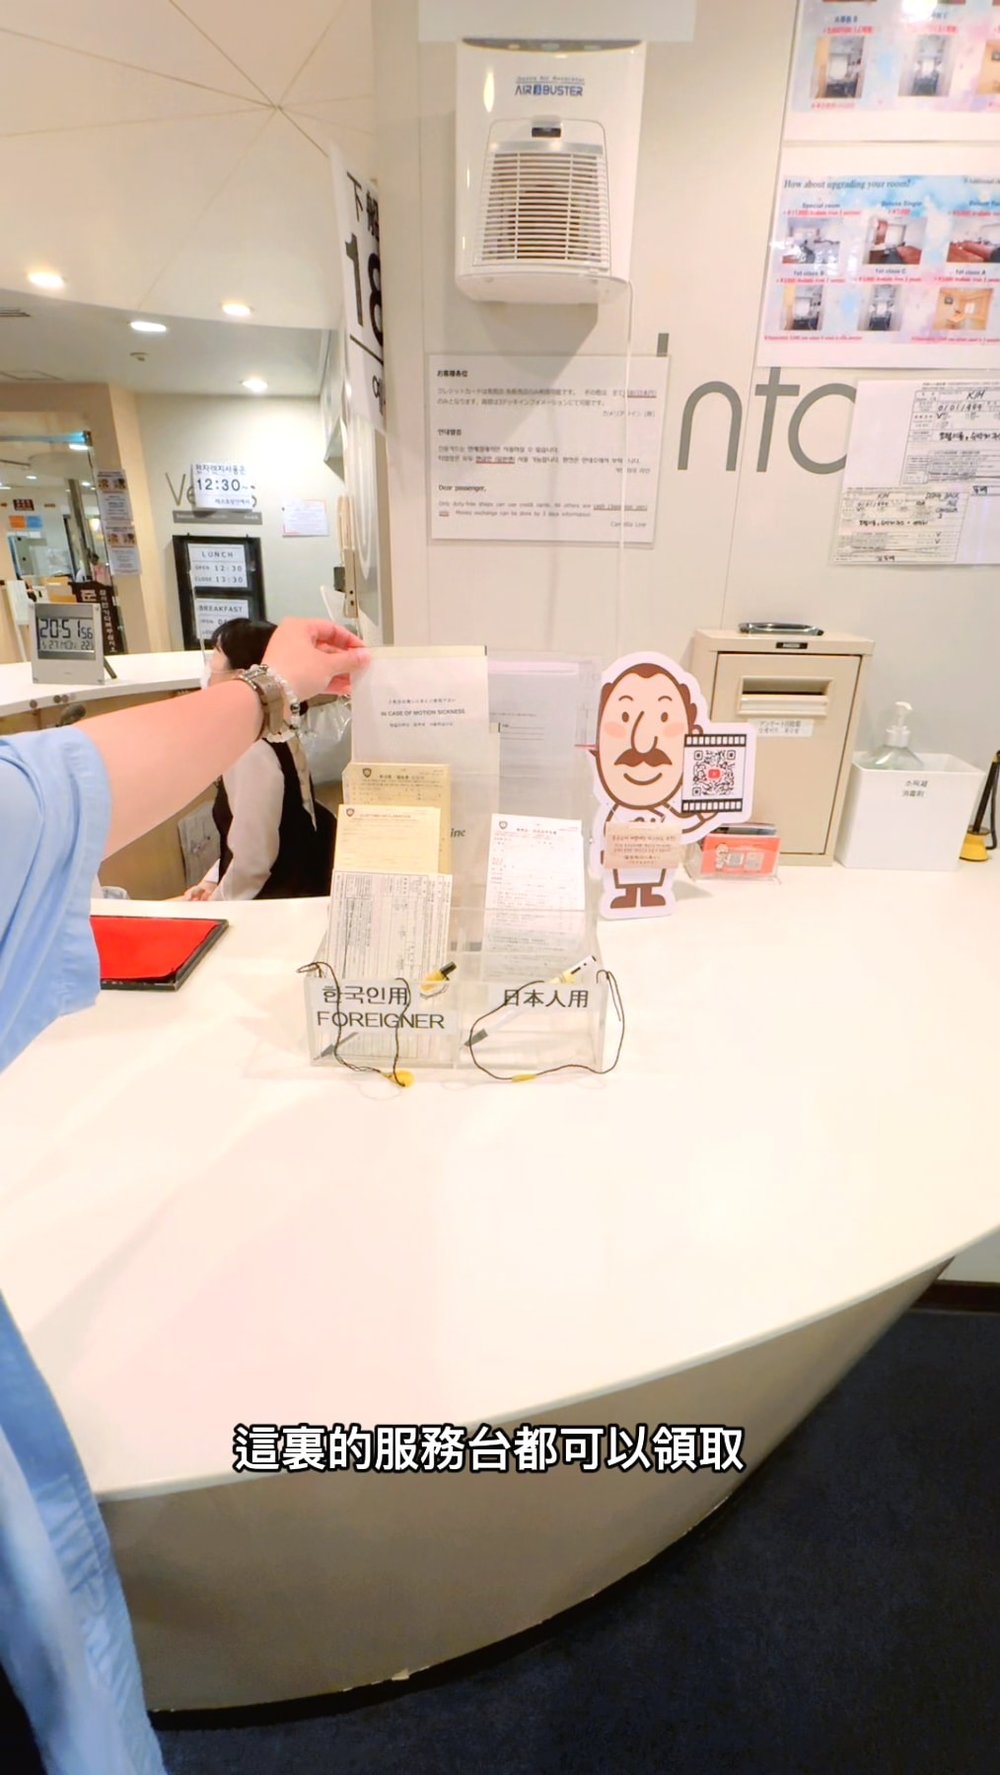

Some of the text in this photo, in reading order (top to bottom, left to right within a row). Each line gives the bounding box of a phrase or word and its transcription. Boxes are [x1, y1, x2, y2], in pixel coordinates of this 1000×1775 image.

[542, 85, 583, 96] BUSTER
[784, 179, 803, 188] How
[803, 179, 825, 189] about
[826, 180, 865, 190] upgrading
[867, 181, 884, 190] your
[438, 484, 453, 492] Dear
[214, 564, 243, 573] 12:30
[199, 605, 243, 613] BREAKFAST
[503, 988, 589, 1008] 日本人用
[316, 1010, 445, 1029] FOREIGNER
